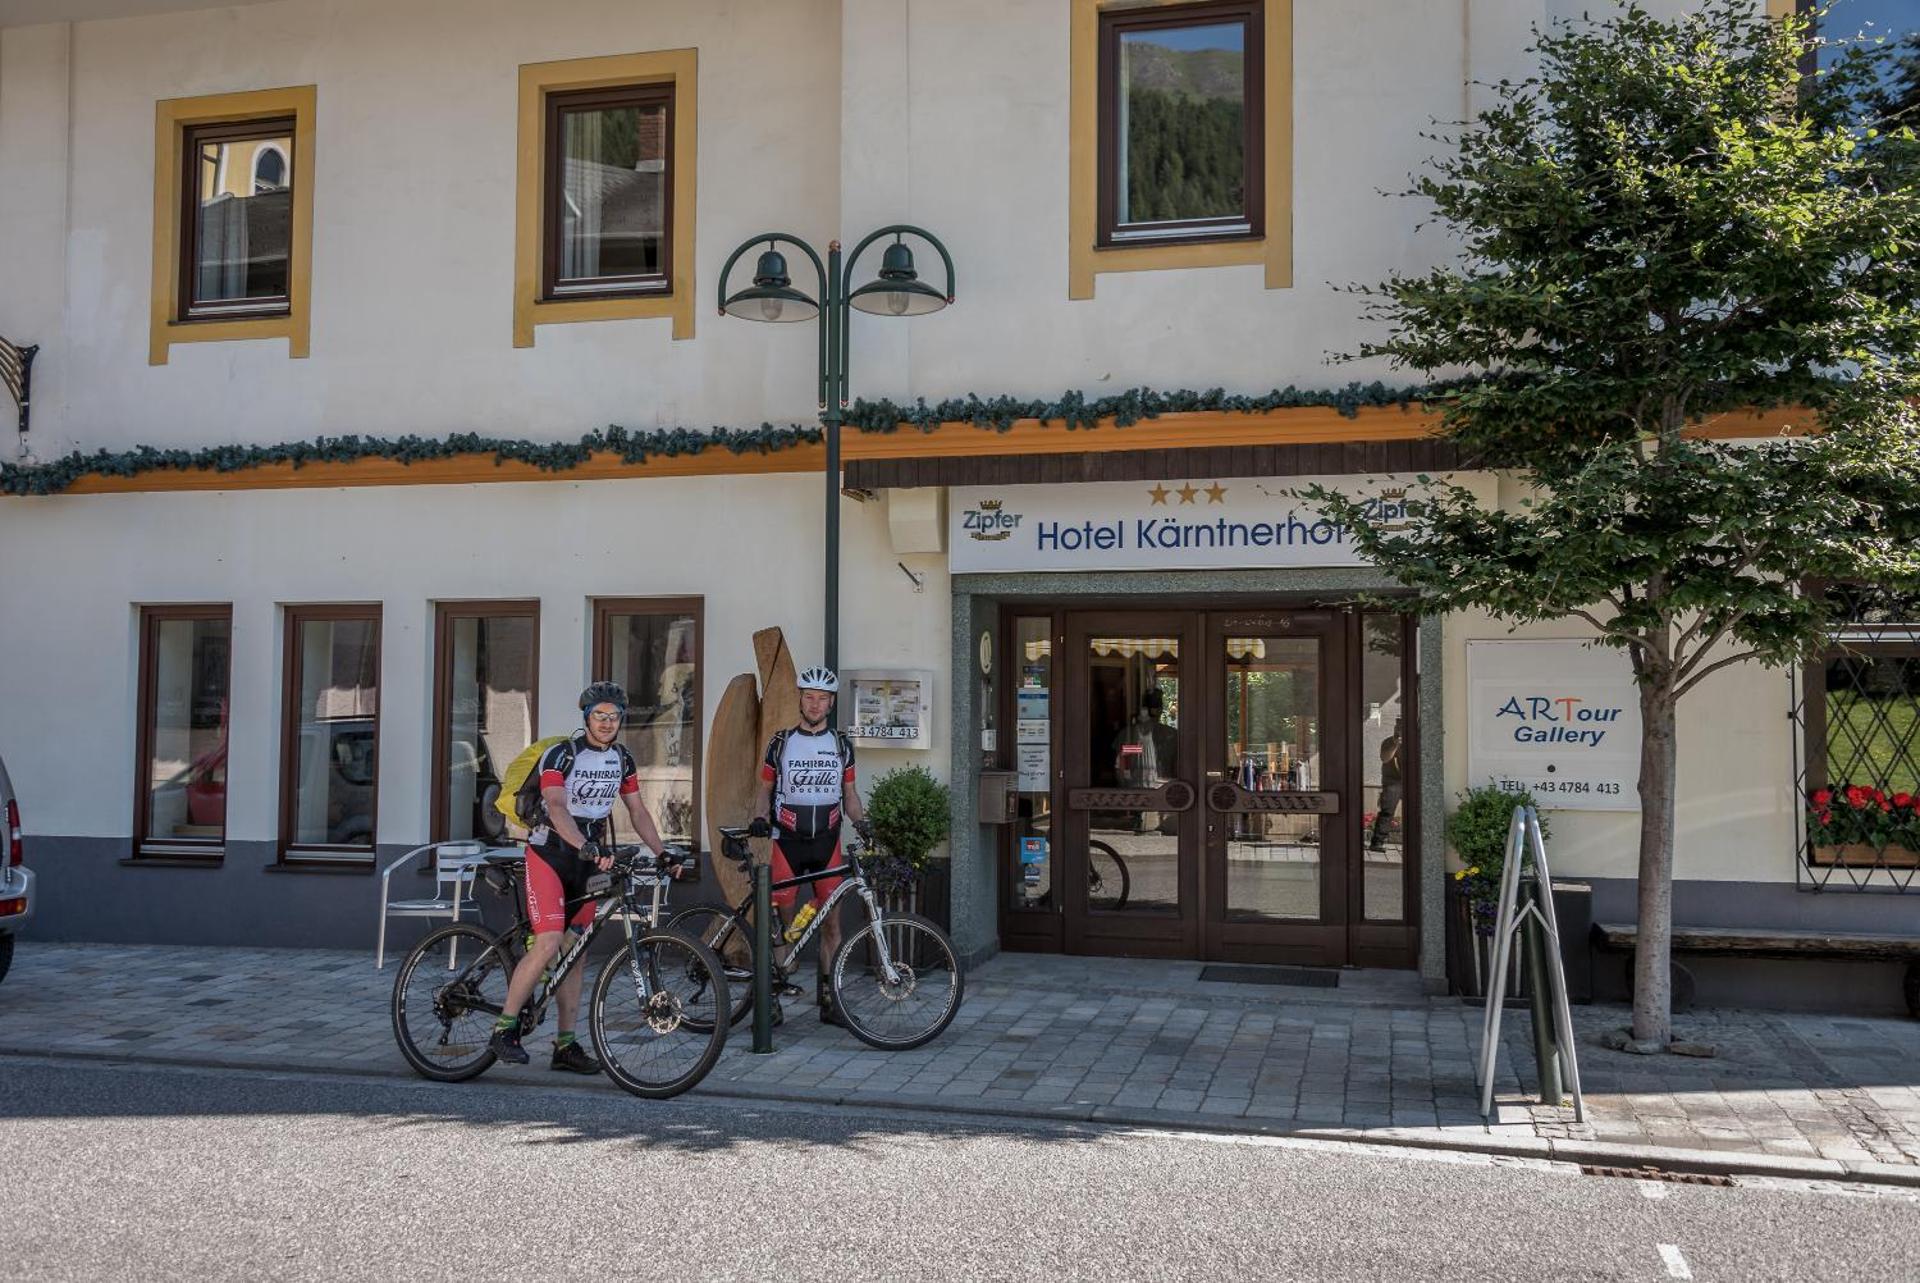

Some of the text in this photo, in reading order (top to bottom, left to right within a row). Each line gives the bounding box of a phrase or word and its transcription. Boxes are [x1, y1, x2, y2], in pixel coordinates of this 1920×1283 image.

[1361, 498, 1412, 523] Zipf
[963, 509, 1023, 533] Zipfer
[1037, 520, 1124, 550] Hotel
[1495, 695, 1622, 722] ARTour
[868, 726, 893, 737] 4784
[899, 728, 919, 738] 413
[1513, 725, 1606, 747] Gallery
[788, 759, 839, 769] FAHRRAD
[574, 770, 622, 779] FAHRRAD
[792, 769, 836, 787] Grille
[1532, 781, 1556, 792] +43
[1558, 781, 1590, 793] 4784
[1597, 782, 1621, 794] 413
